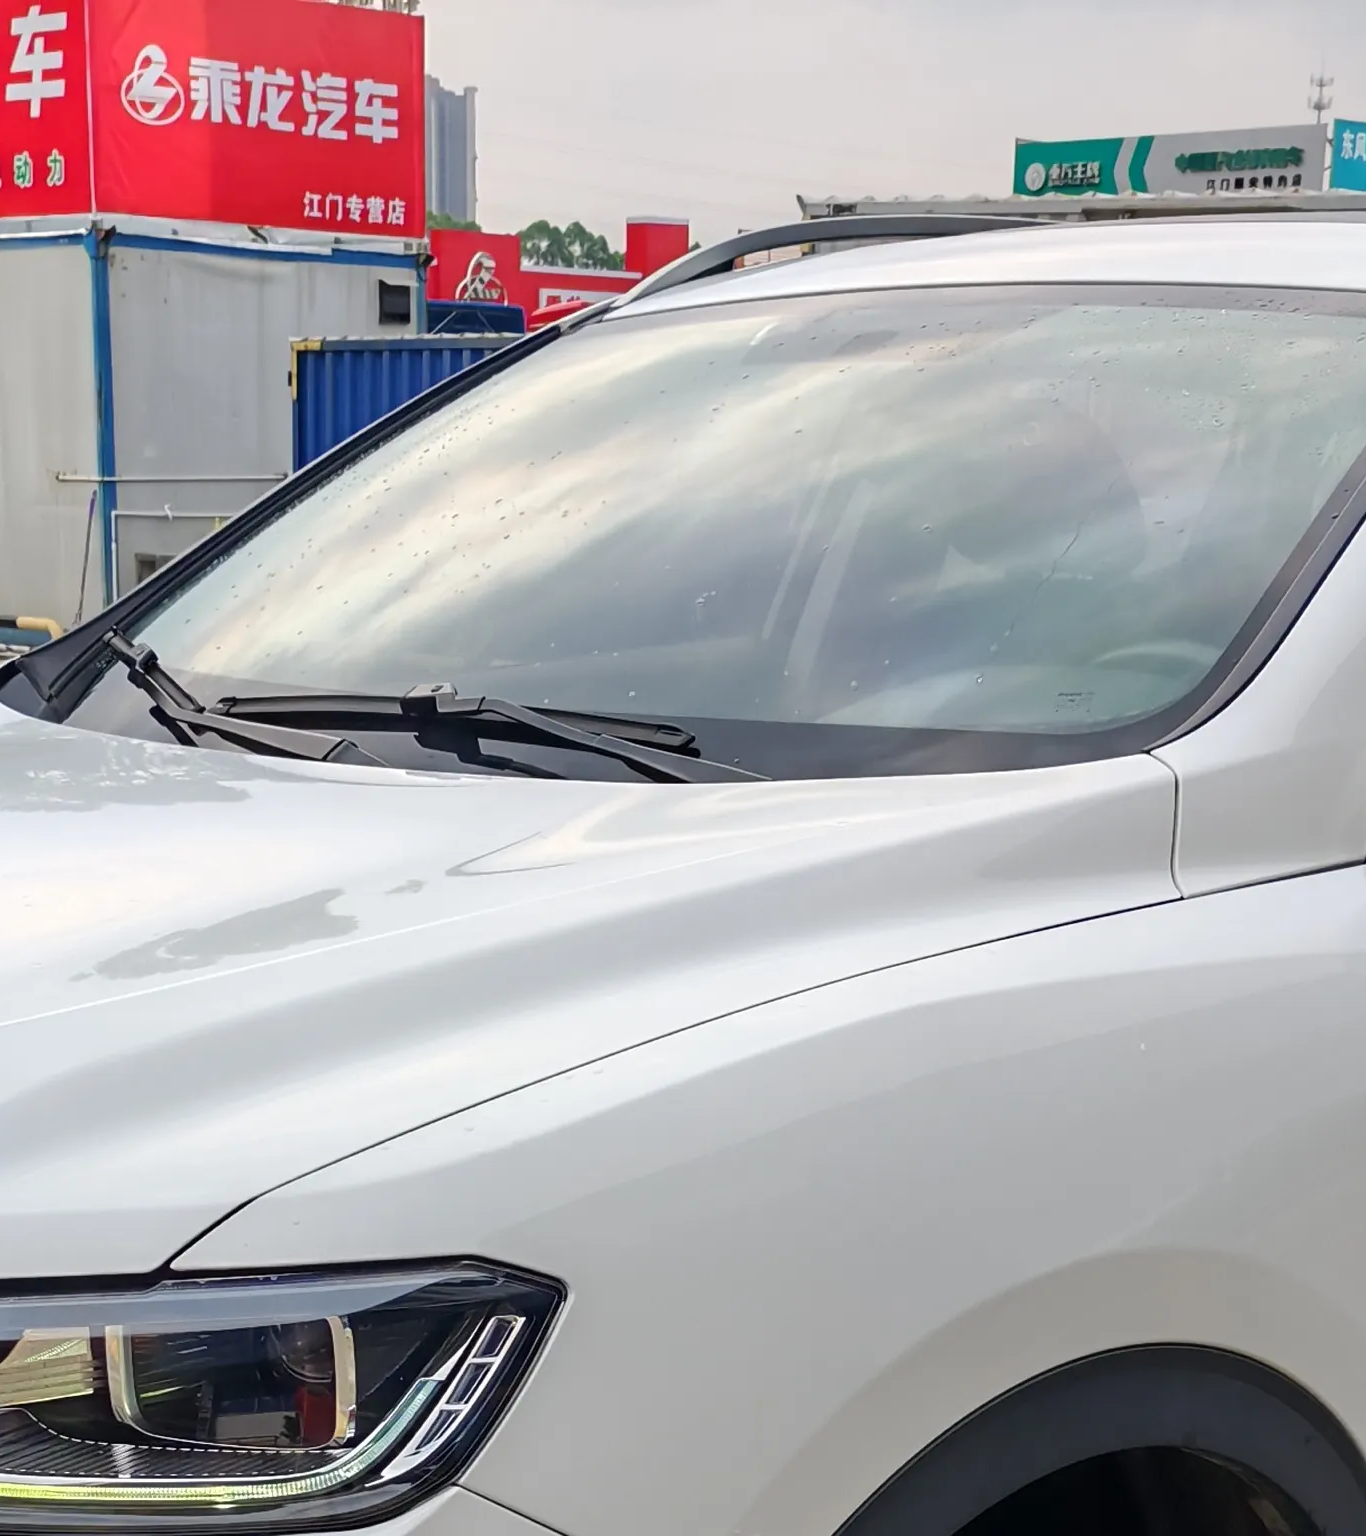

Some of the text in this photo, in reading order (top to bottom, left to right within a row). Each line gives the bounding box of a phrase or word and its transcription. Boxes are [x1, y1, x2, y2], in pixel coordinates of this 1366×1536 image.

[189, 56, 399, 144] 乘龙汽车
[303, 191, 406, 226] 江门专营店
